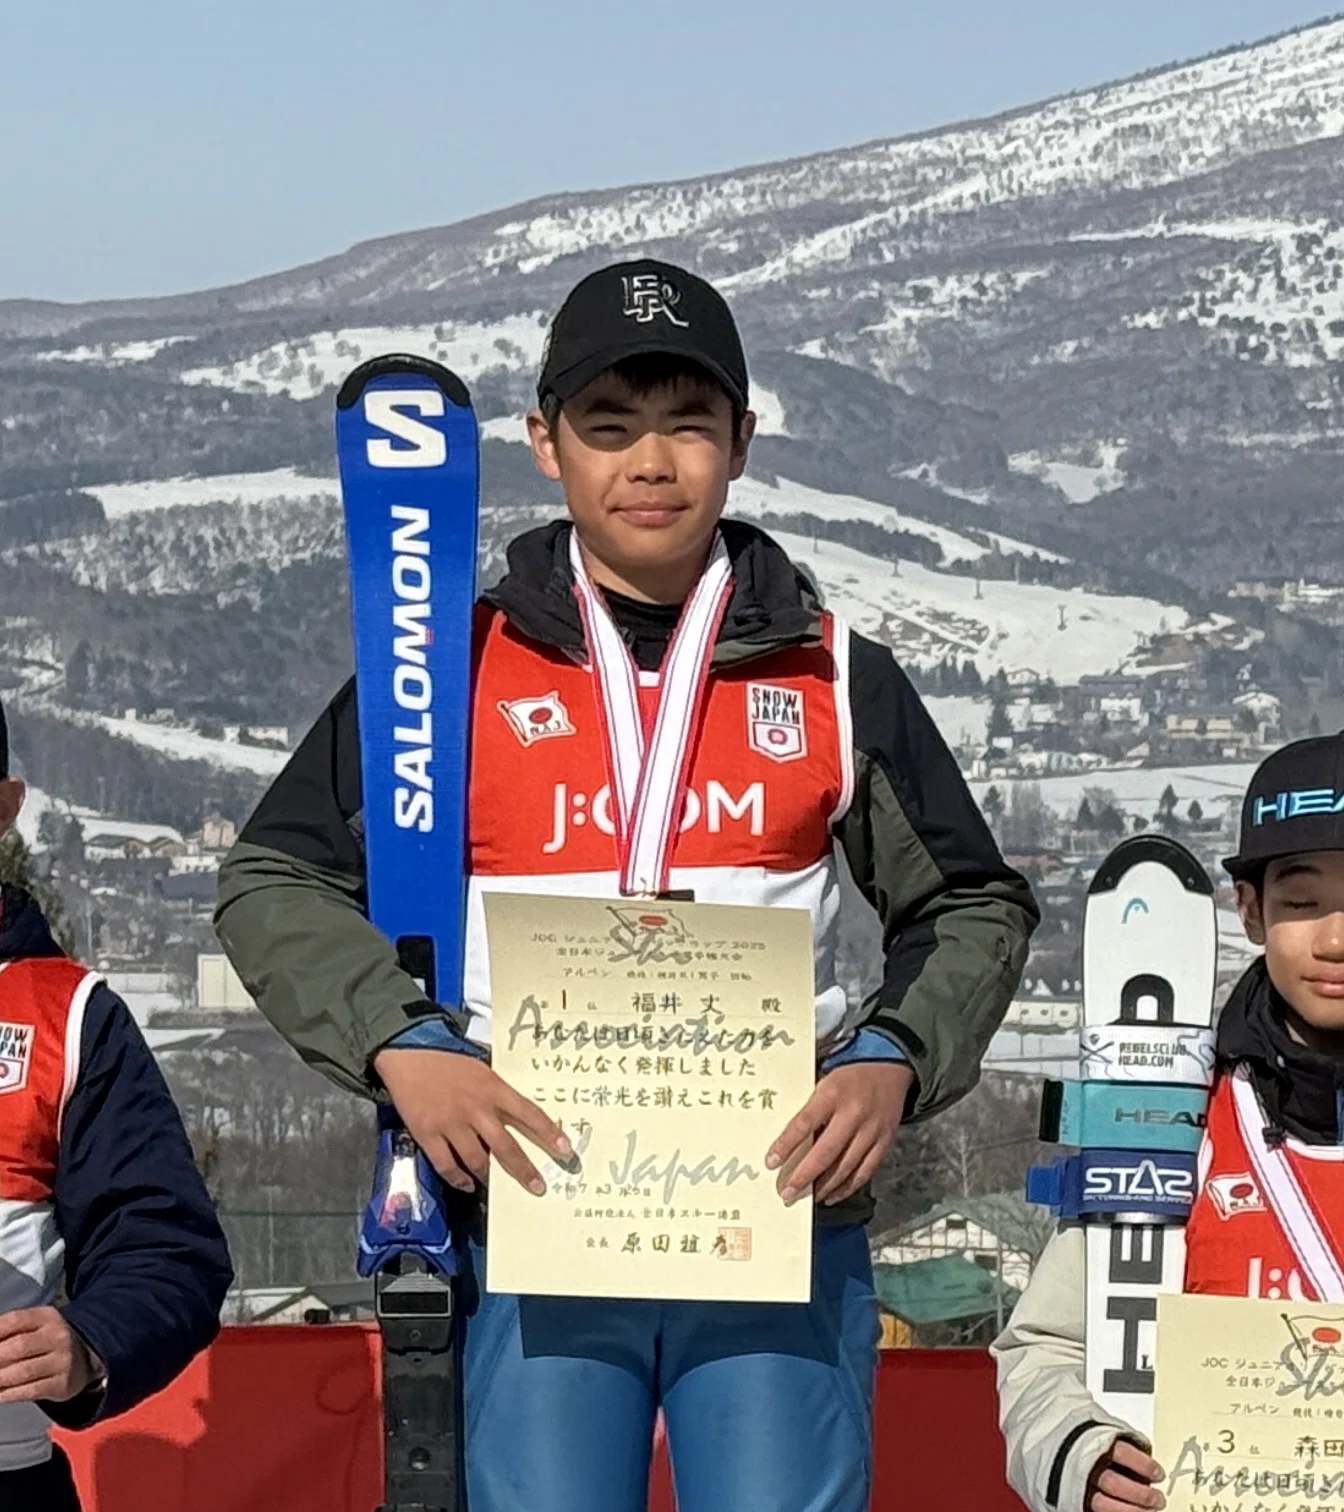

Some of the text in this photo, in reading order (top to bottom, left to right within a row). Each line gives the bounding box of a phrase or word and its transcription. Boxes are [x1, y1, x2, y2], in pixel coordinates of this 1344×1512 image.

[391, 504, 434, 834] SALOMON
[752, 687, 798, 709] SNOW
[752, 705, 800, 725] JAPAN
[543, 781, 765, 854] J:CM
[632, 991, 682, 1015] 福井
[531, 1056, 757, 1077] いかんなく発揮しました
[1142, 1354, 1154, 1370] L
[1201, 1356, 1229, 1370] JOC
